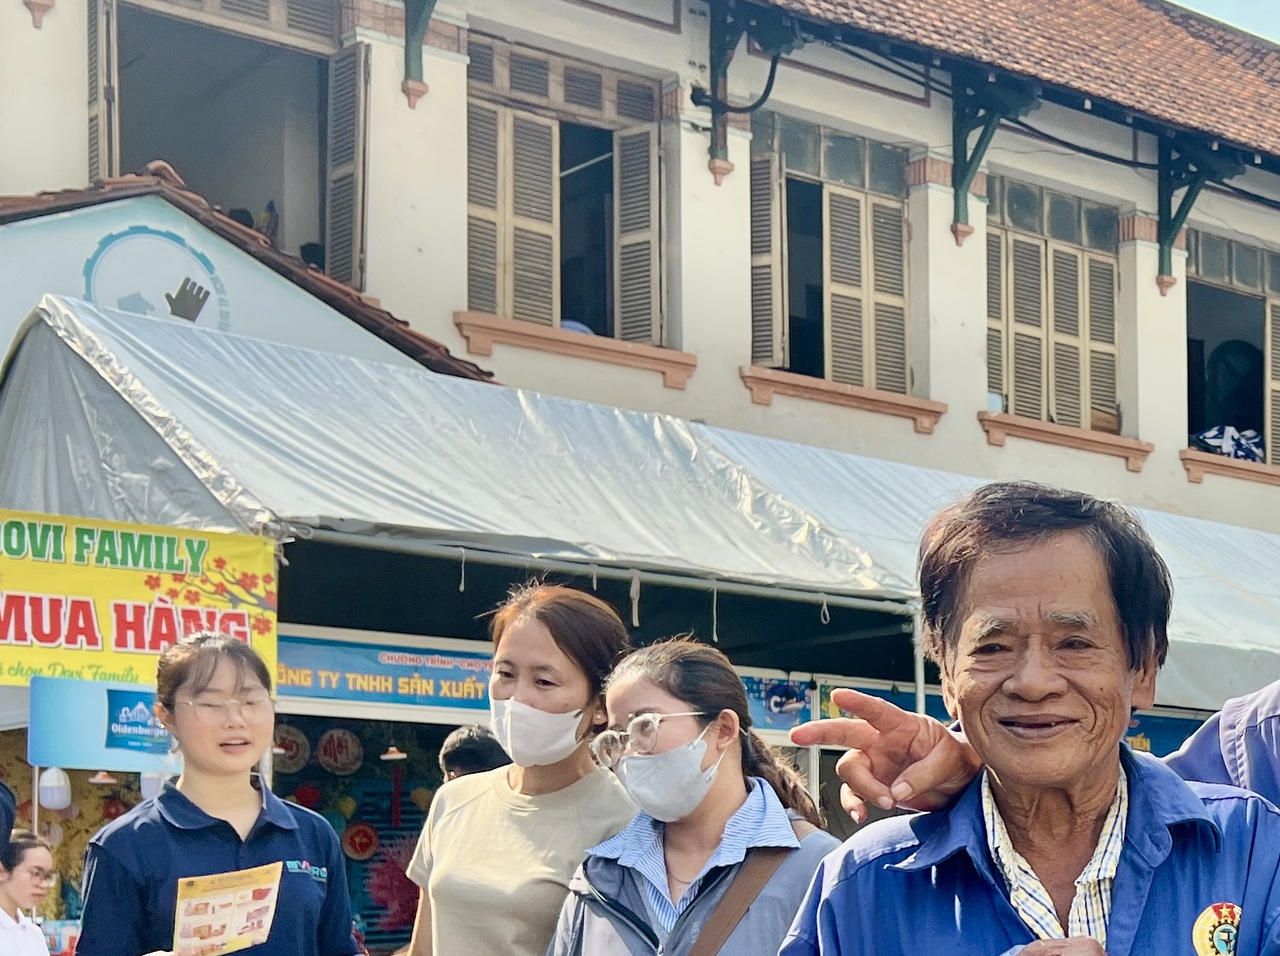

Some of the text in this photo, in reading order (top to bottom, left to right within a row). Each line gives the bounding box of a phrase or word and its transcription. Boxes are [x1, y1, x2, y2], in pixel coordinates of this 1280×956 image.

[0, 519, 208, 576] OVI FAMILY
[0, 592, 251, 652] MUA HÀNG
[276, 663, 486, 699] ÔNG TY TNHH SẢN XUẤT
